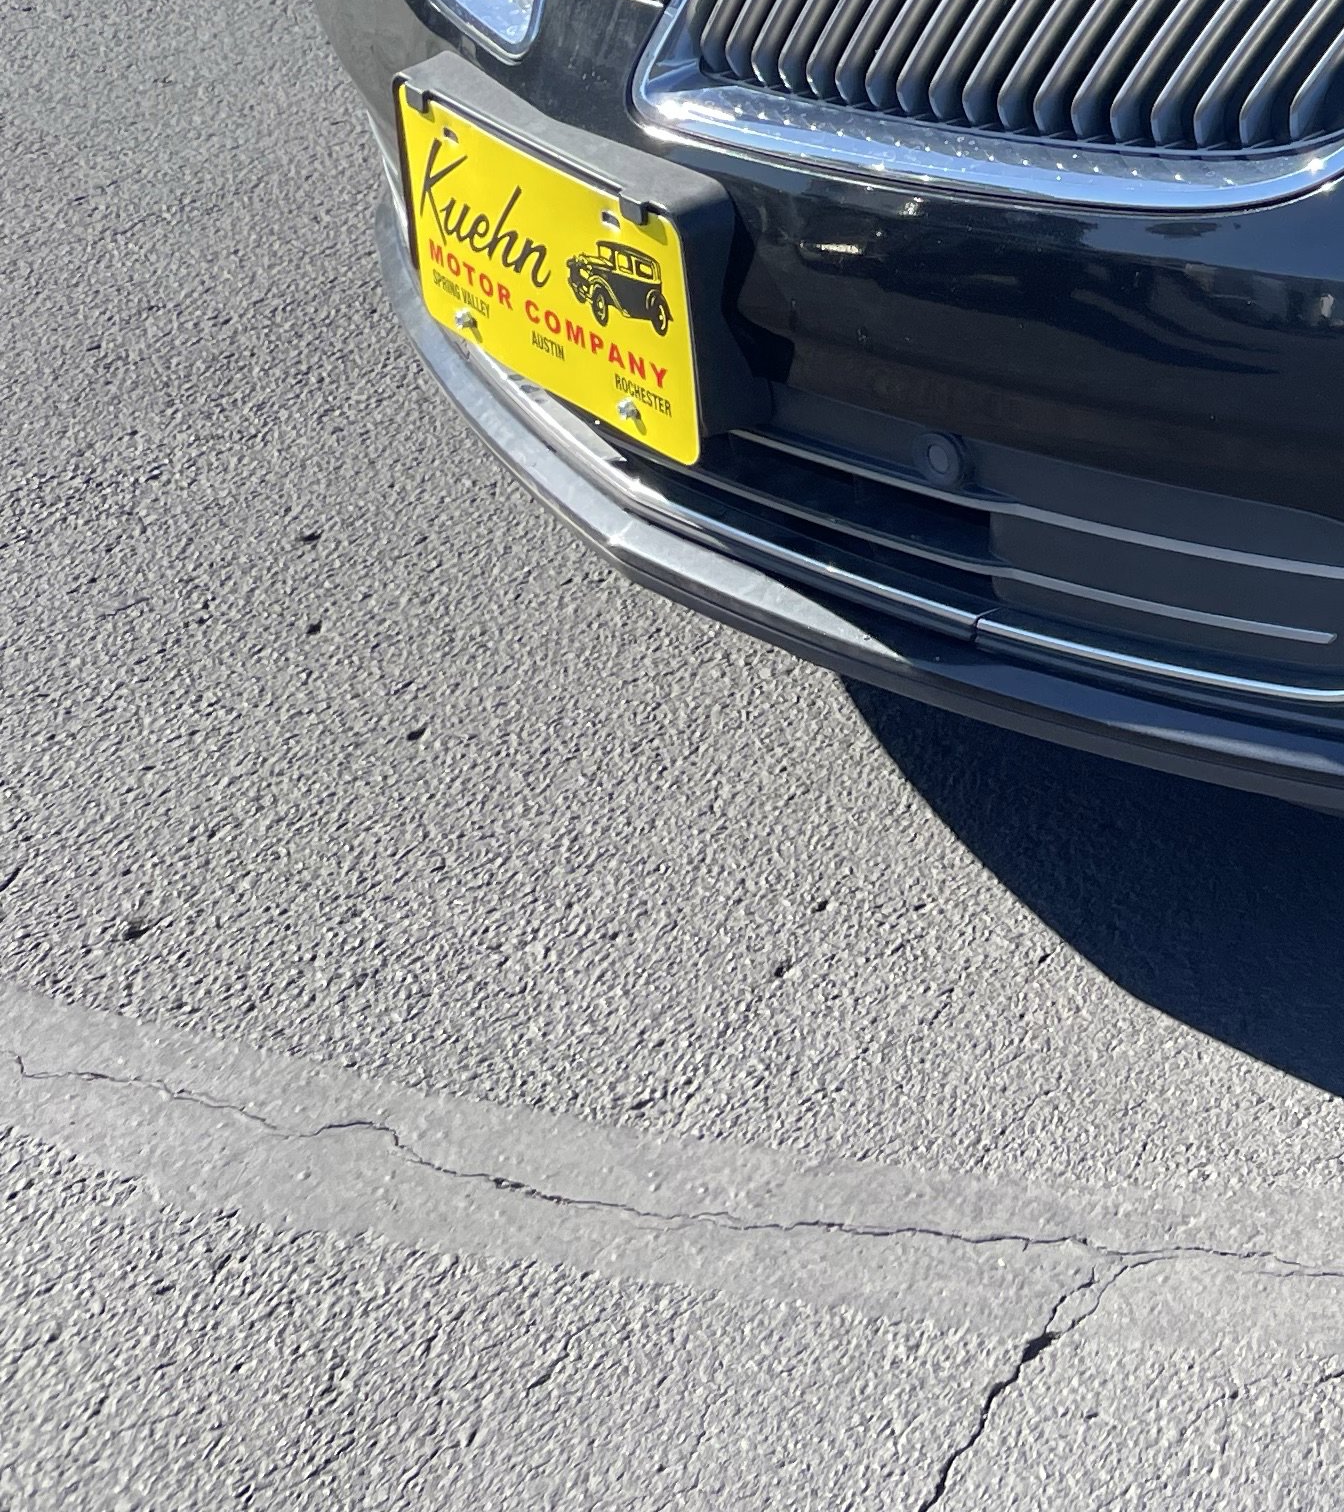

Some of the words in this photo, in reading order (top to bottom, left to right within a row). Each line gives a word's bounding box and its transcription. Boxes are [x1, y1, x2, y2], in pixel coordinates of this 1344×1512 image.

[420, 137, 552, 288] Kuehn
[428, 238, 514, 311] MOTOR
[524, 299, 669, 389] COMPANY
[432, 268, 461, 302] SPRING
[460, 286, 490, 319] VALLEY
[531, 330, 566, 362] AUSTIN
[614, 373, 673, 418] ROCHESTER
